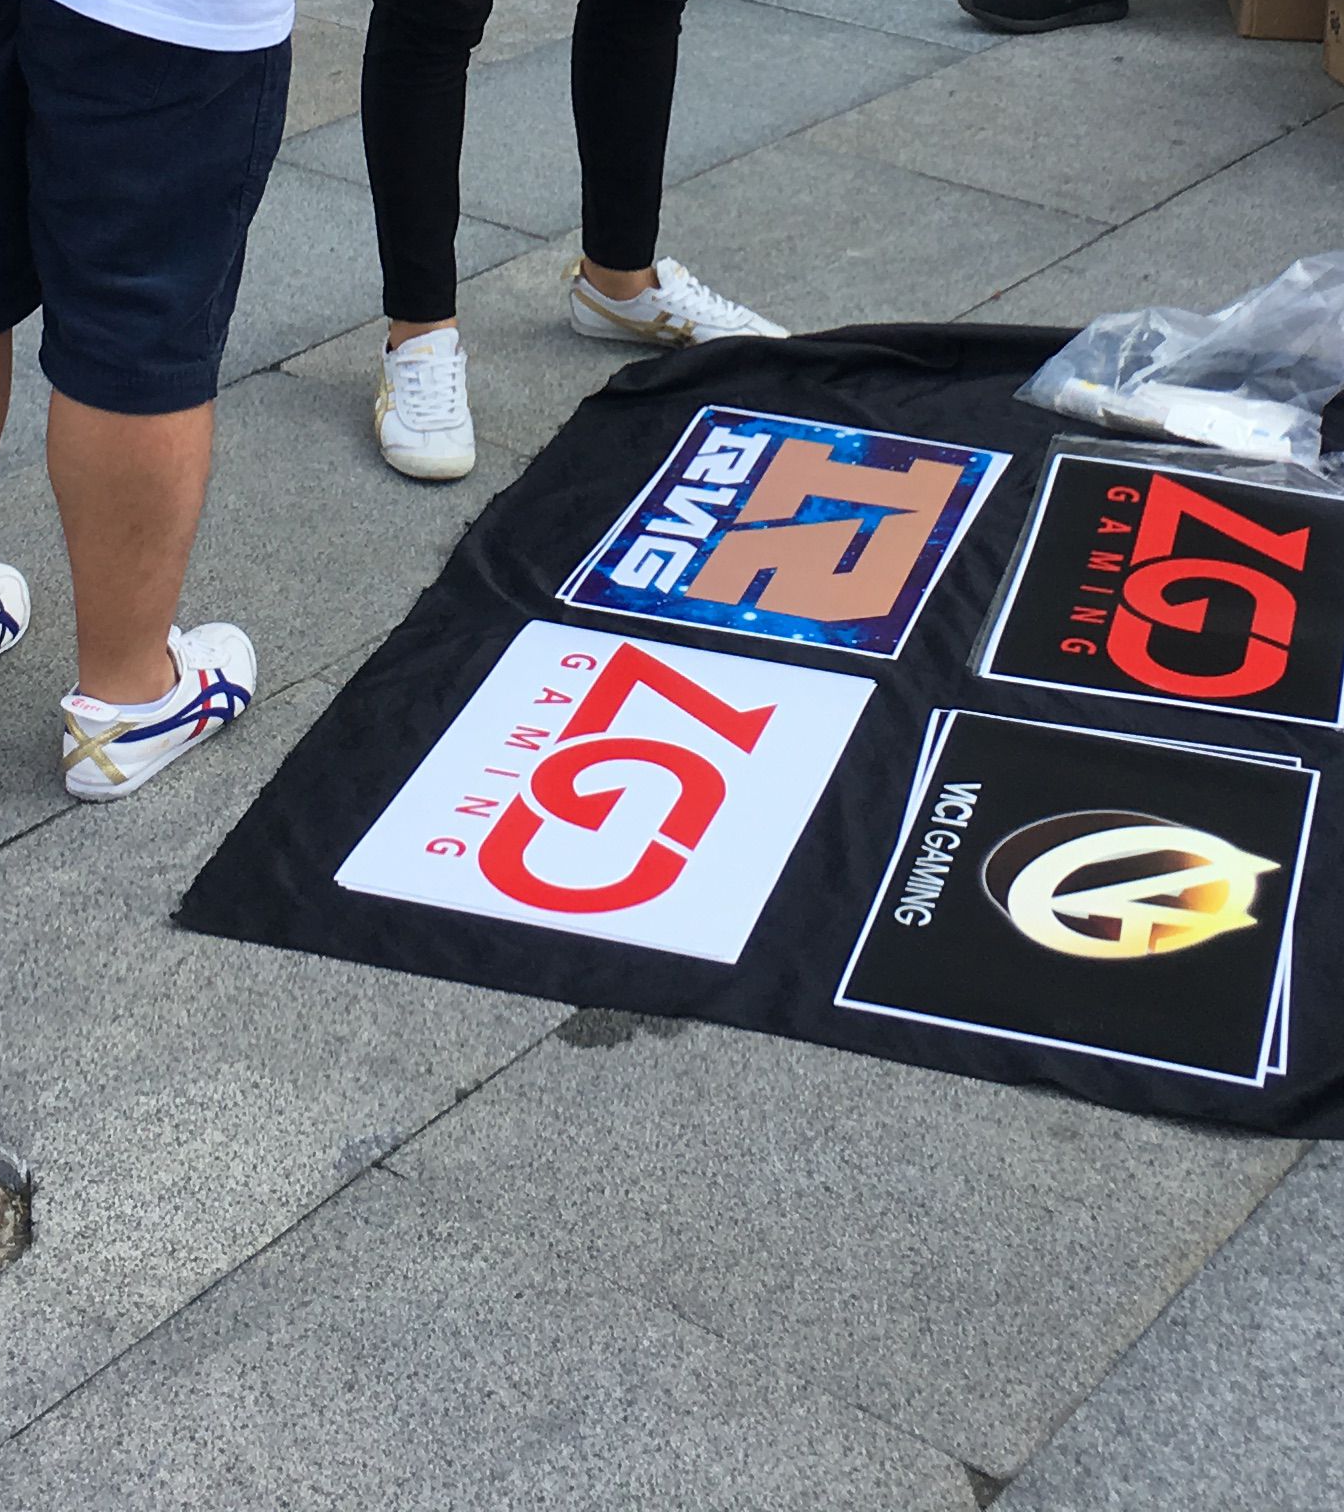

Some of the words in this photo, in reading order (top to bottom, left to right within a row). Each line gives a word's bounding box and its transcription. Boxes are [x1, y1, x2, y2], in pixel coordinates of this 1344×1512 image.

[609, 426, 773, 595] RNG
[1059, 485, 1142, 656] GAMING
[1105, 471, 1312, 699] LGD
[424, 652, 599, 861] GAMING
[478, 642, 777, 914] LGD
[930, 782, 983, 830] VICI
[893, 831, 961, 927] GAMING
